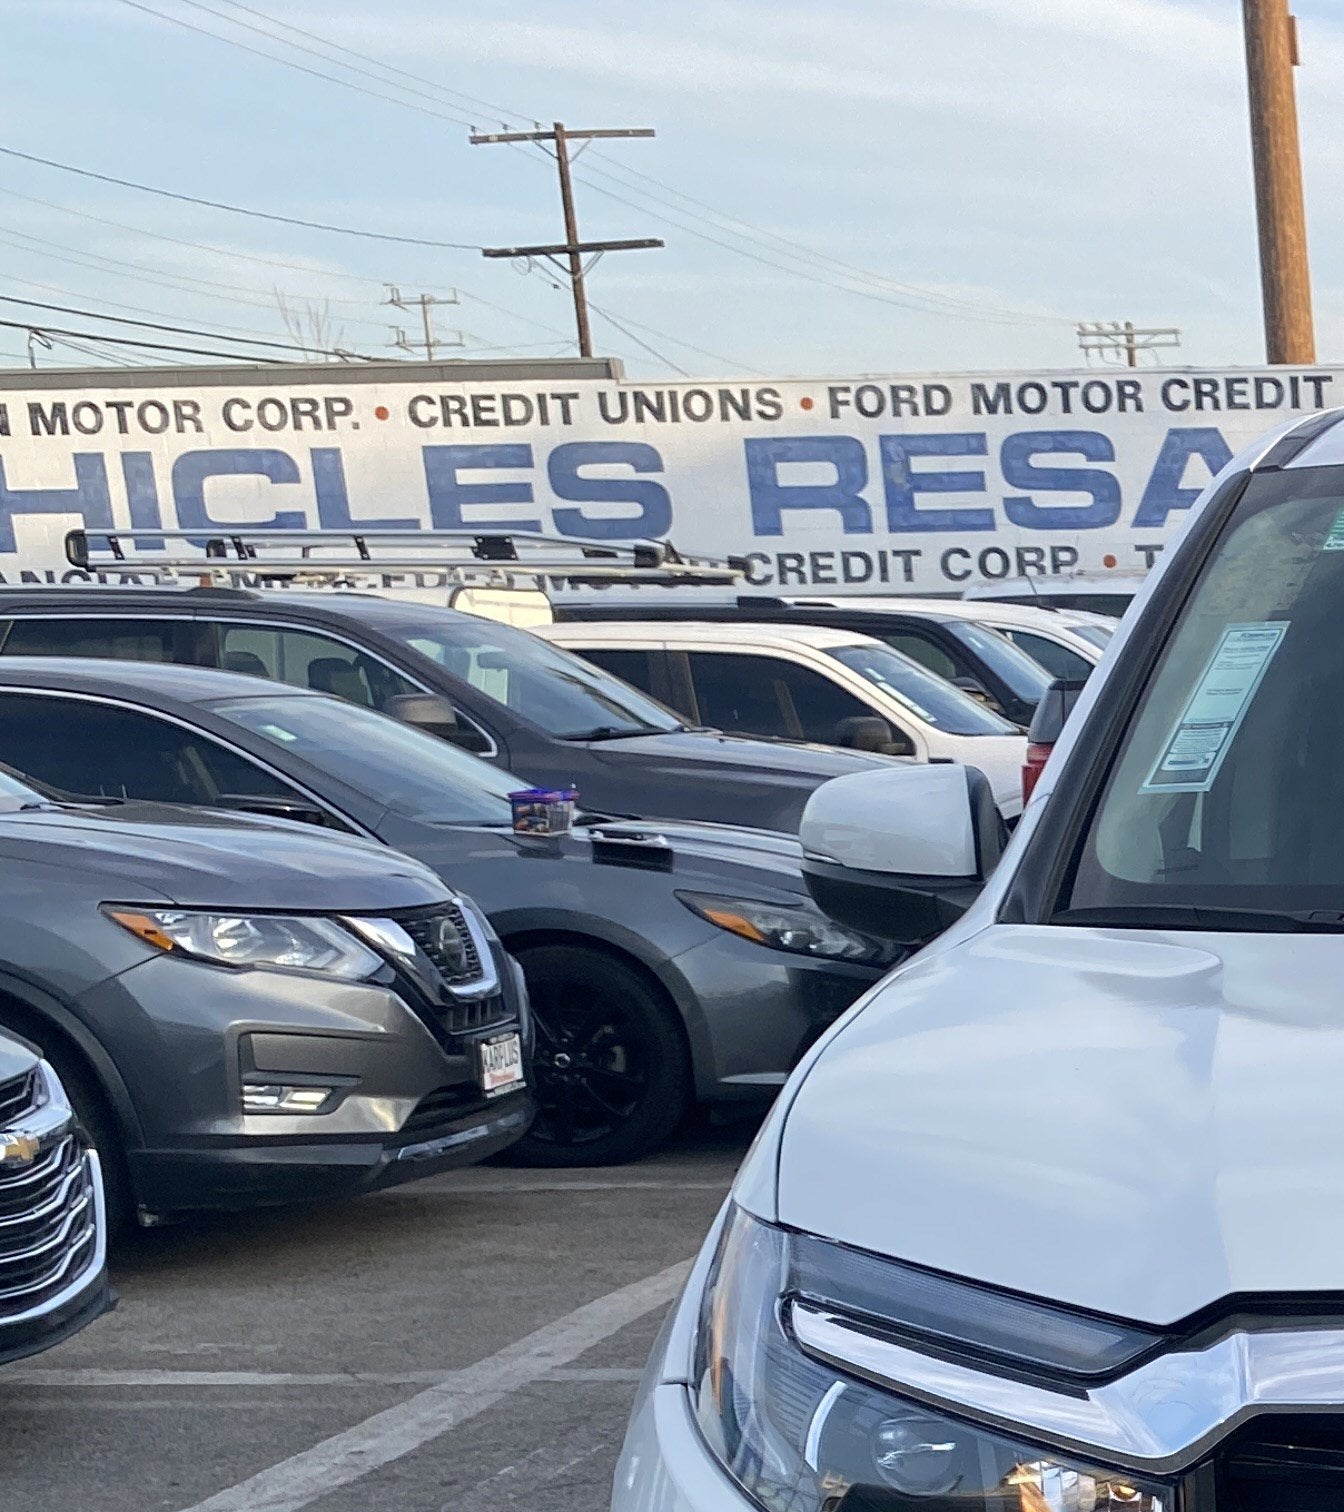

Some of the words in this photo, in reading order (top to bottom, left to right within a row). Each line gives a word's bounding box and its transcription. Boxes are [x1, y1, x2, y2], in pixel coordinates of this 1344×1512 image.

[27, 400, 203, 436] MOTOR
[222, 396, 361, 432] CORP.
[408, 392, 580, 429] CREDIT
[598, 387, 784, 425] UNIONS
[828, 384, 952, 419] FORD
[971, 379, 1144, 416] MOTOR
[1160, 375, 1333, 412] CREDIT
[744, 550, 922, 587] CREDIT
